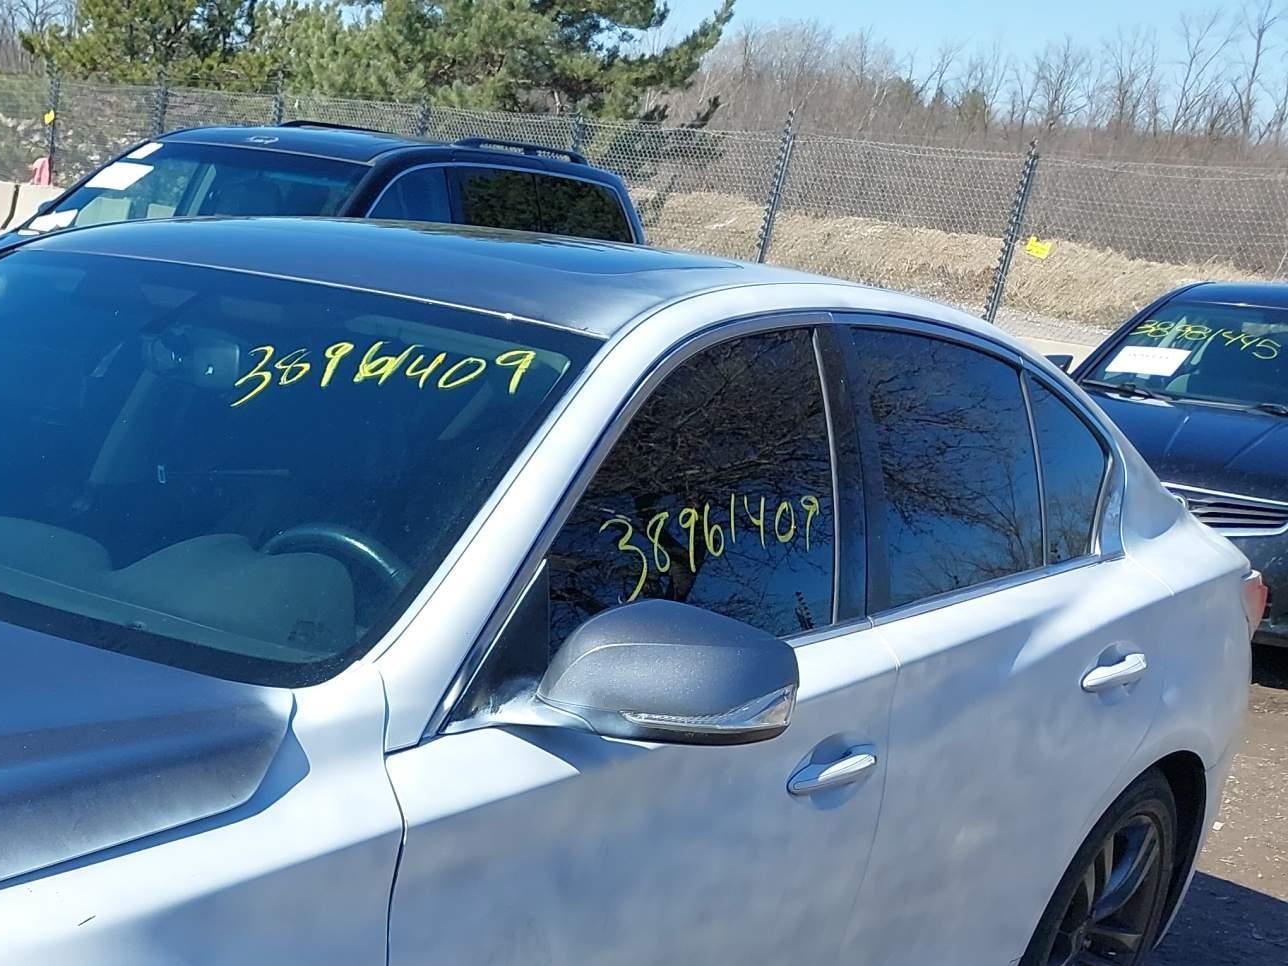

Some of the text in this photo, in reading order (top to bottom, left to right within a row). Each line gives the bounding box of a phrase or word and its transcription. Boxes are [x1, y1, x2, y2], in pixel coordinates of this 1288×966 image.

[1128, 319, 1282, 360] 38981445
[230, 341, 537, 407] 38961409
[599, 493, 820, 603] 38961409
